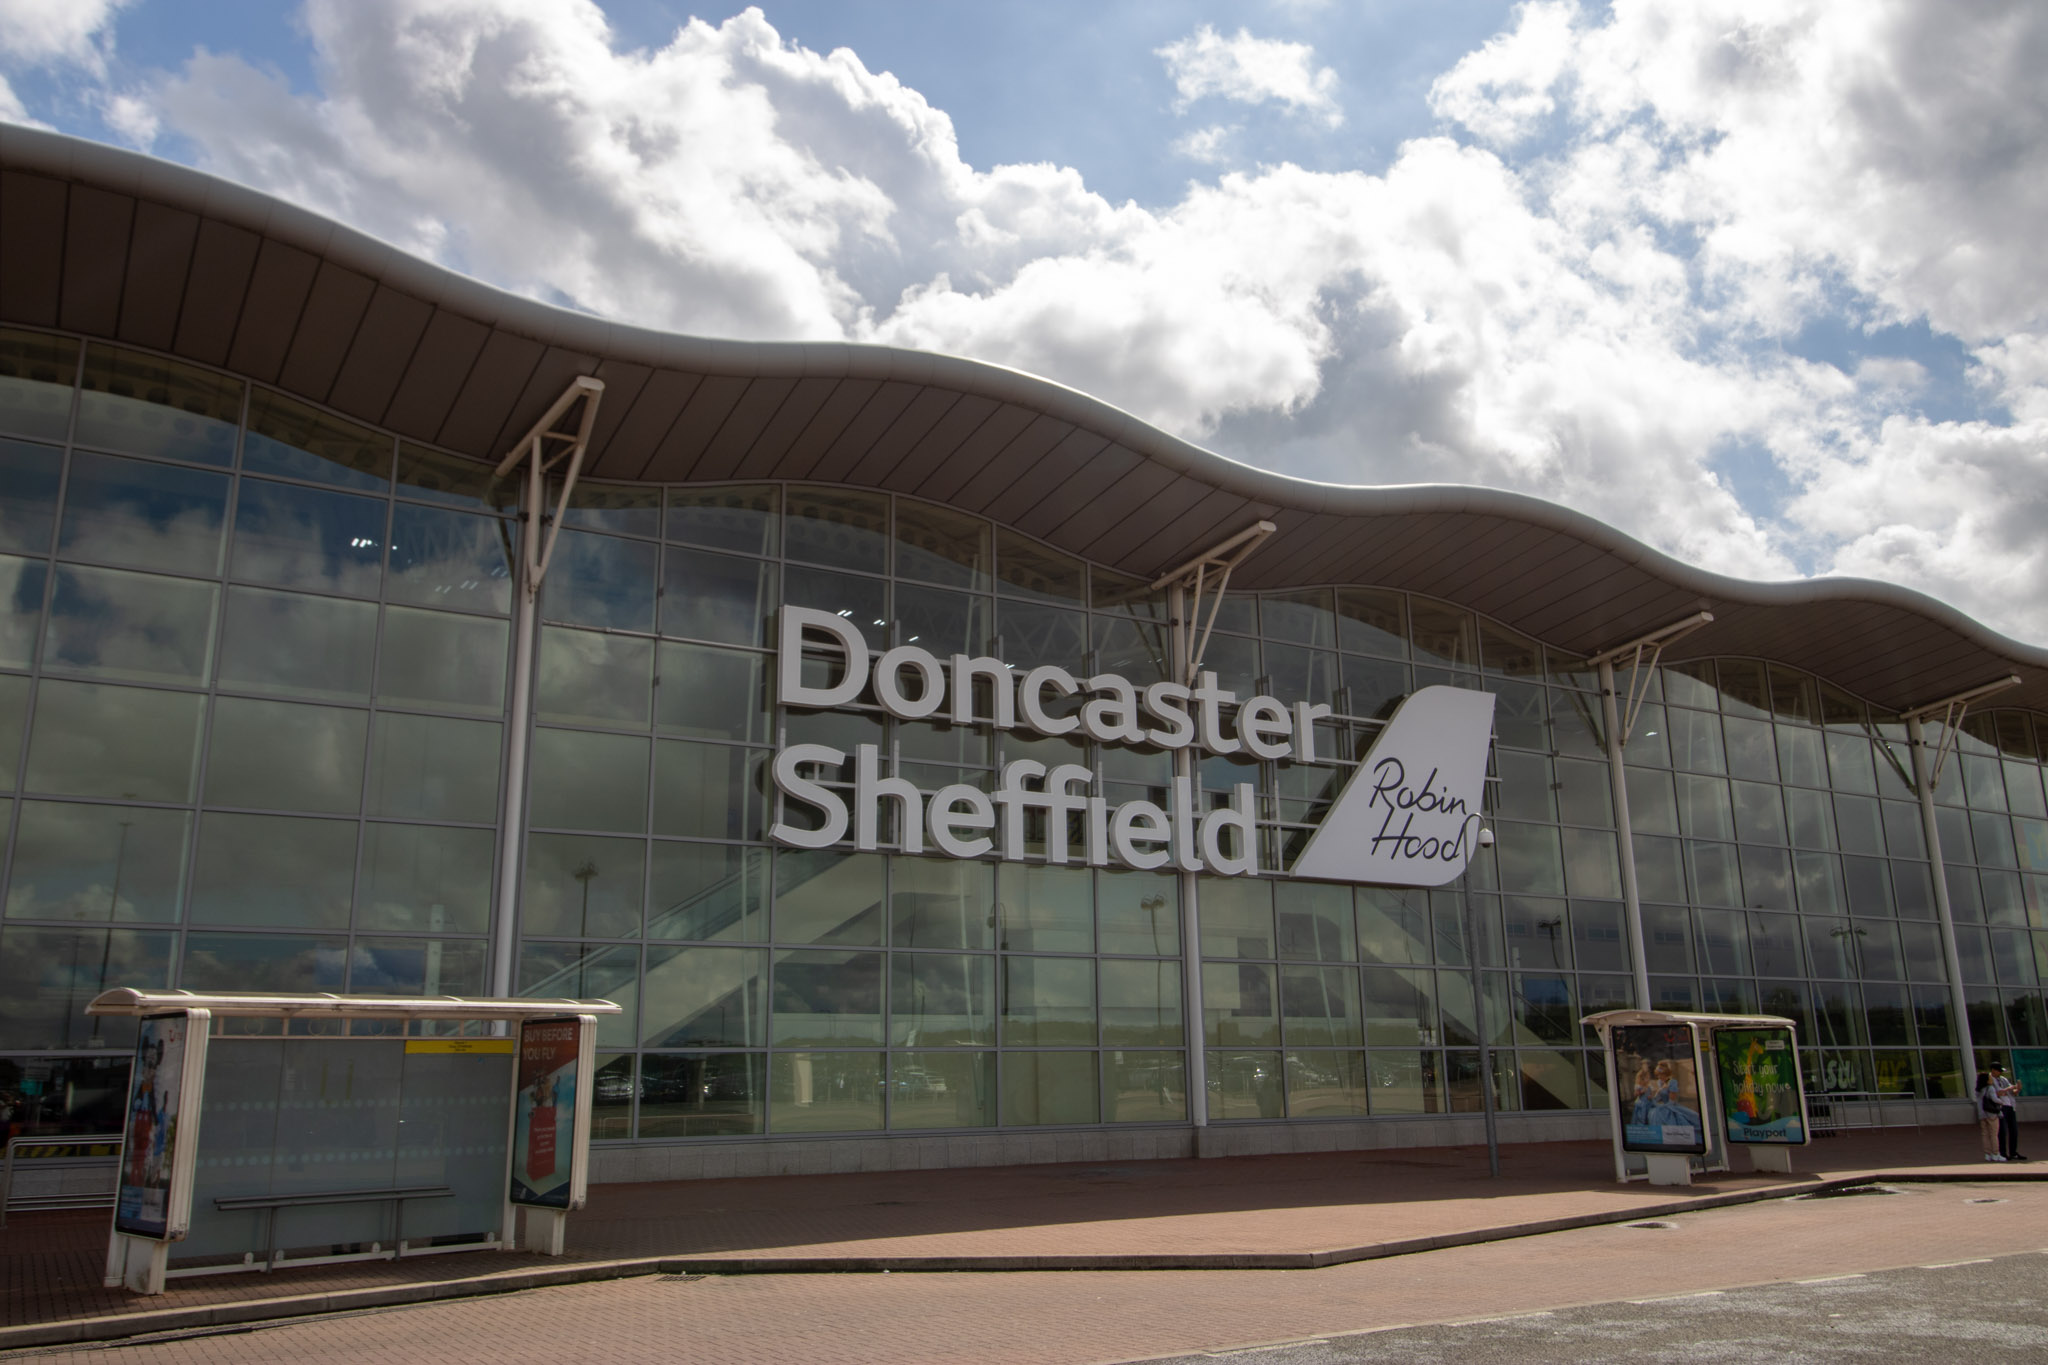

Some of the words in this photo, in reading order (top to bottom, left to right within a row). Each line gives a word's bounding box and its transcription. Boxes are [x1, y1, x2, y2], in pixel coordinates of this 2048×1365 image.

[778, 605, 1332, 763] Doncaster
[1369, 757, 1467, 815] Robin
[769, 743, 1258, 876] Sheffield
[1371, 812, 1466, 862] Hood
[524, 1031, 541, 1042] BUY
[542, 1028, 573, 1041] BEFORE
[523, 1048, 541, 1060] YOU
[1732, 1061, 1756, 1075] Start
[1758, 1064, 1778, 1078] your
[1733, 1080, 1763, 1096] holiday
[1743, 1128, 1786, 1139] Playport
